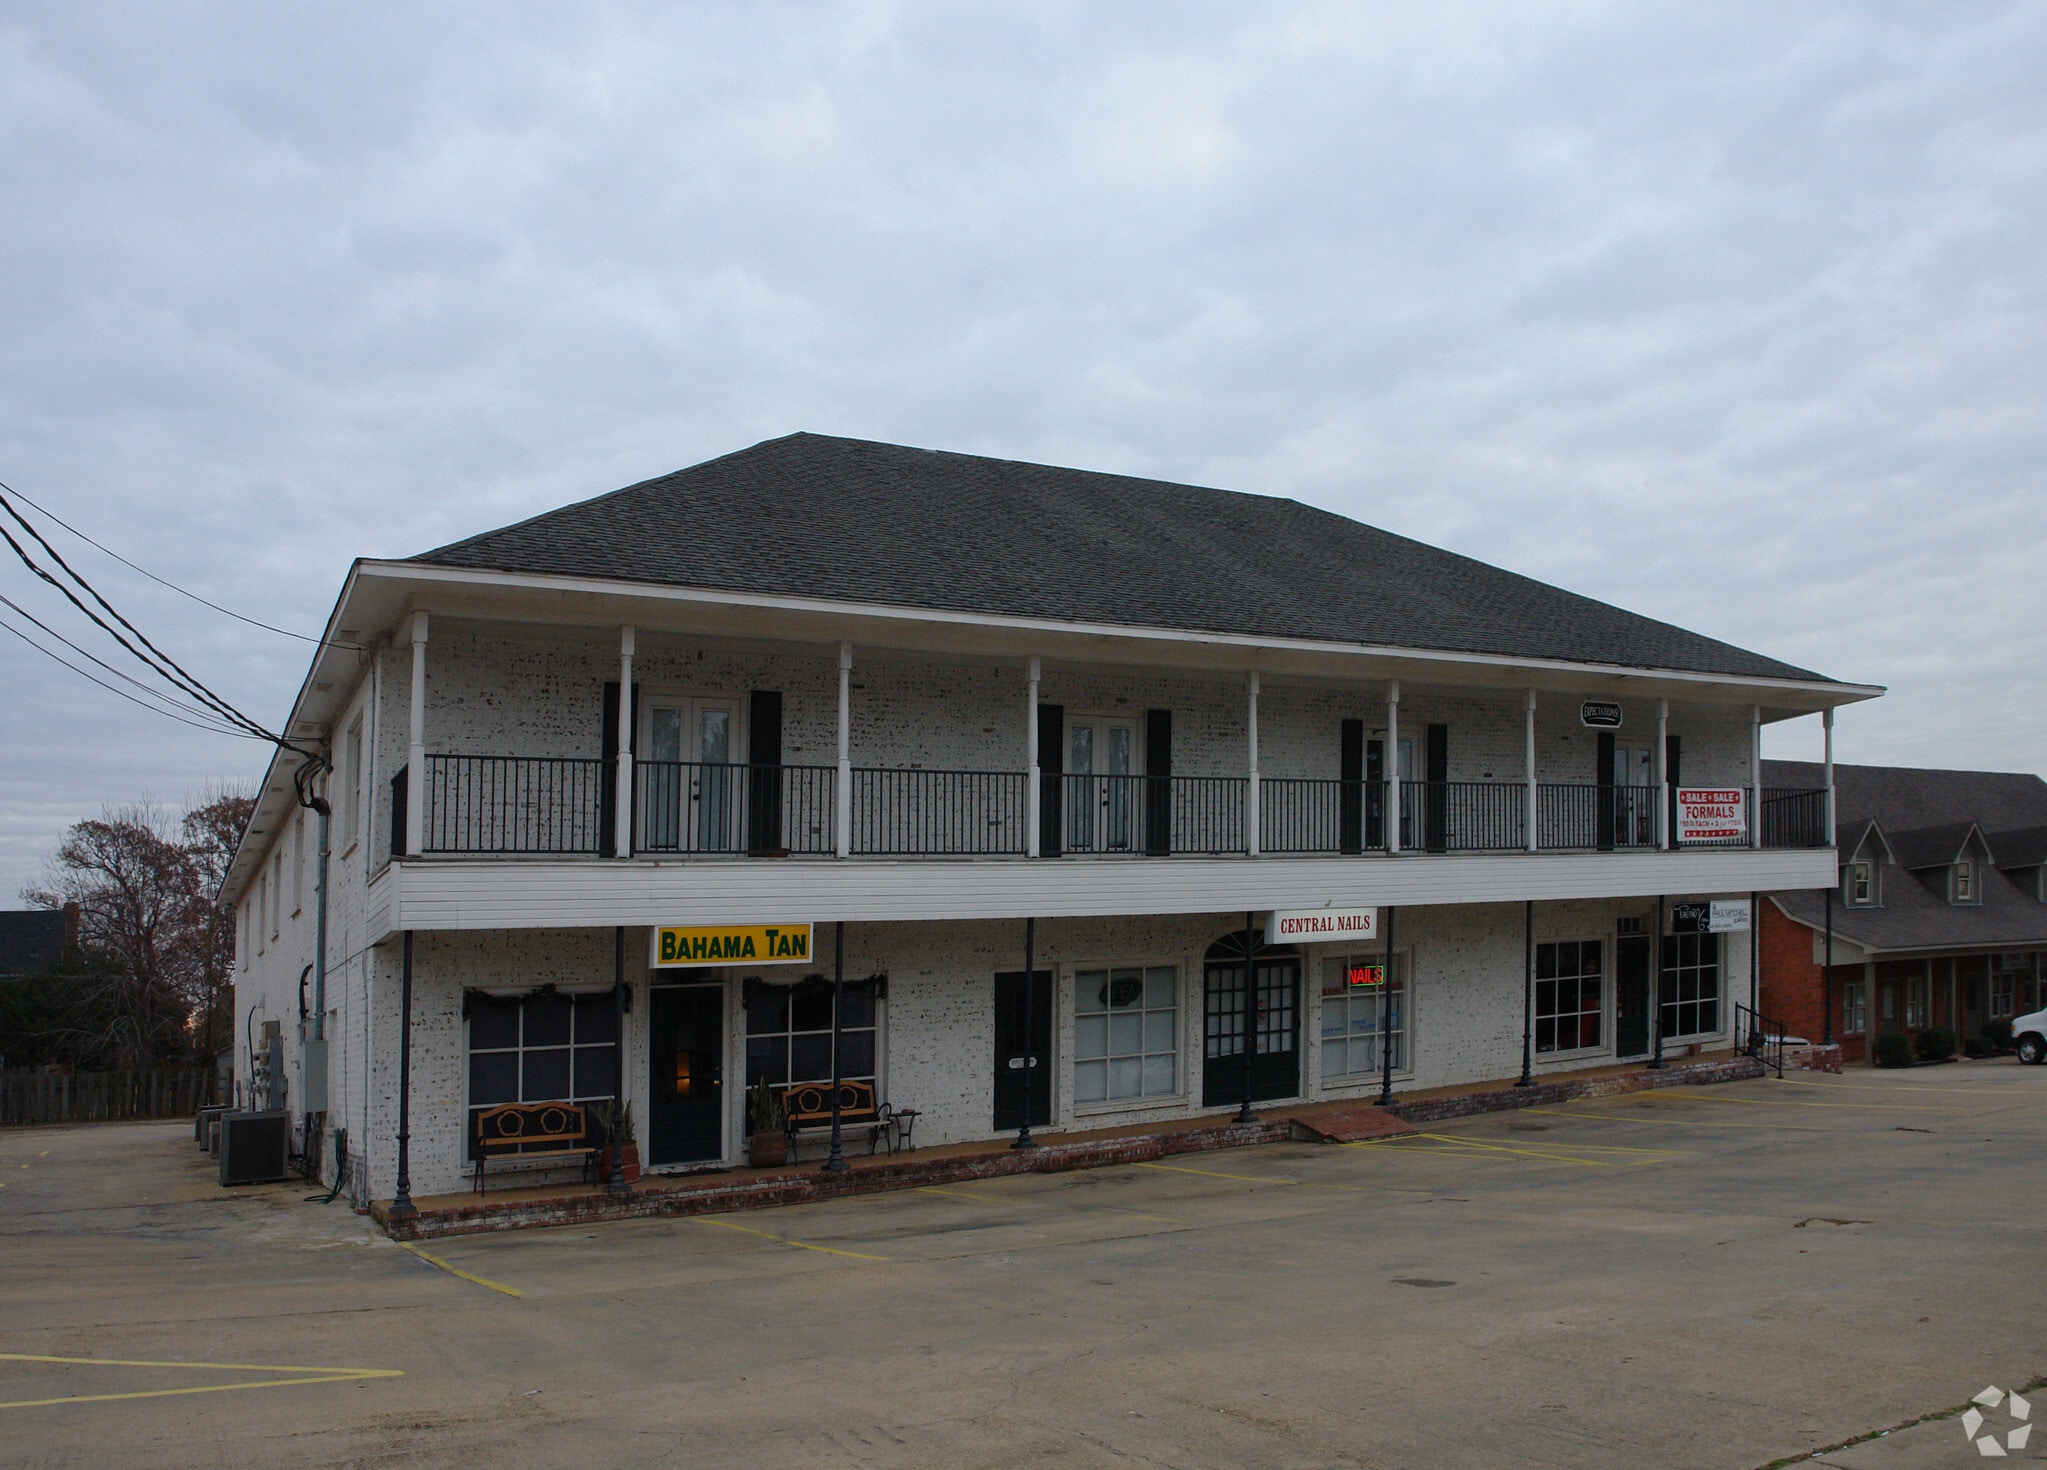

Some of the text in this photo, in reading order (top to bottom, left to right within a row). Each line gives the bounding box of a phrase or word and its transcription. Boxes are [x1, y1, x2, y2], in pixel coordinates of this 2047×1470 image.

[1686, 793, 1734, 802] SALE SALE
[1686, 806, 1735, 819] FORMALS
[1280, 915, 1370, 934] CENTRAL NAILS
[1348, 968, 1383, 984] NAILS
